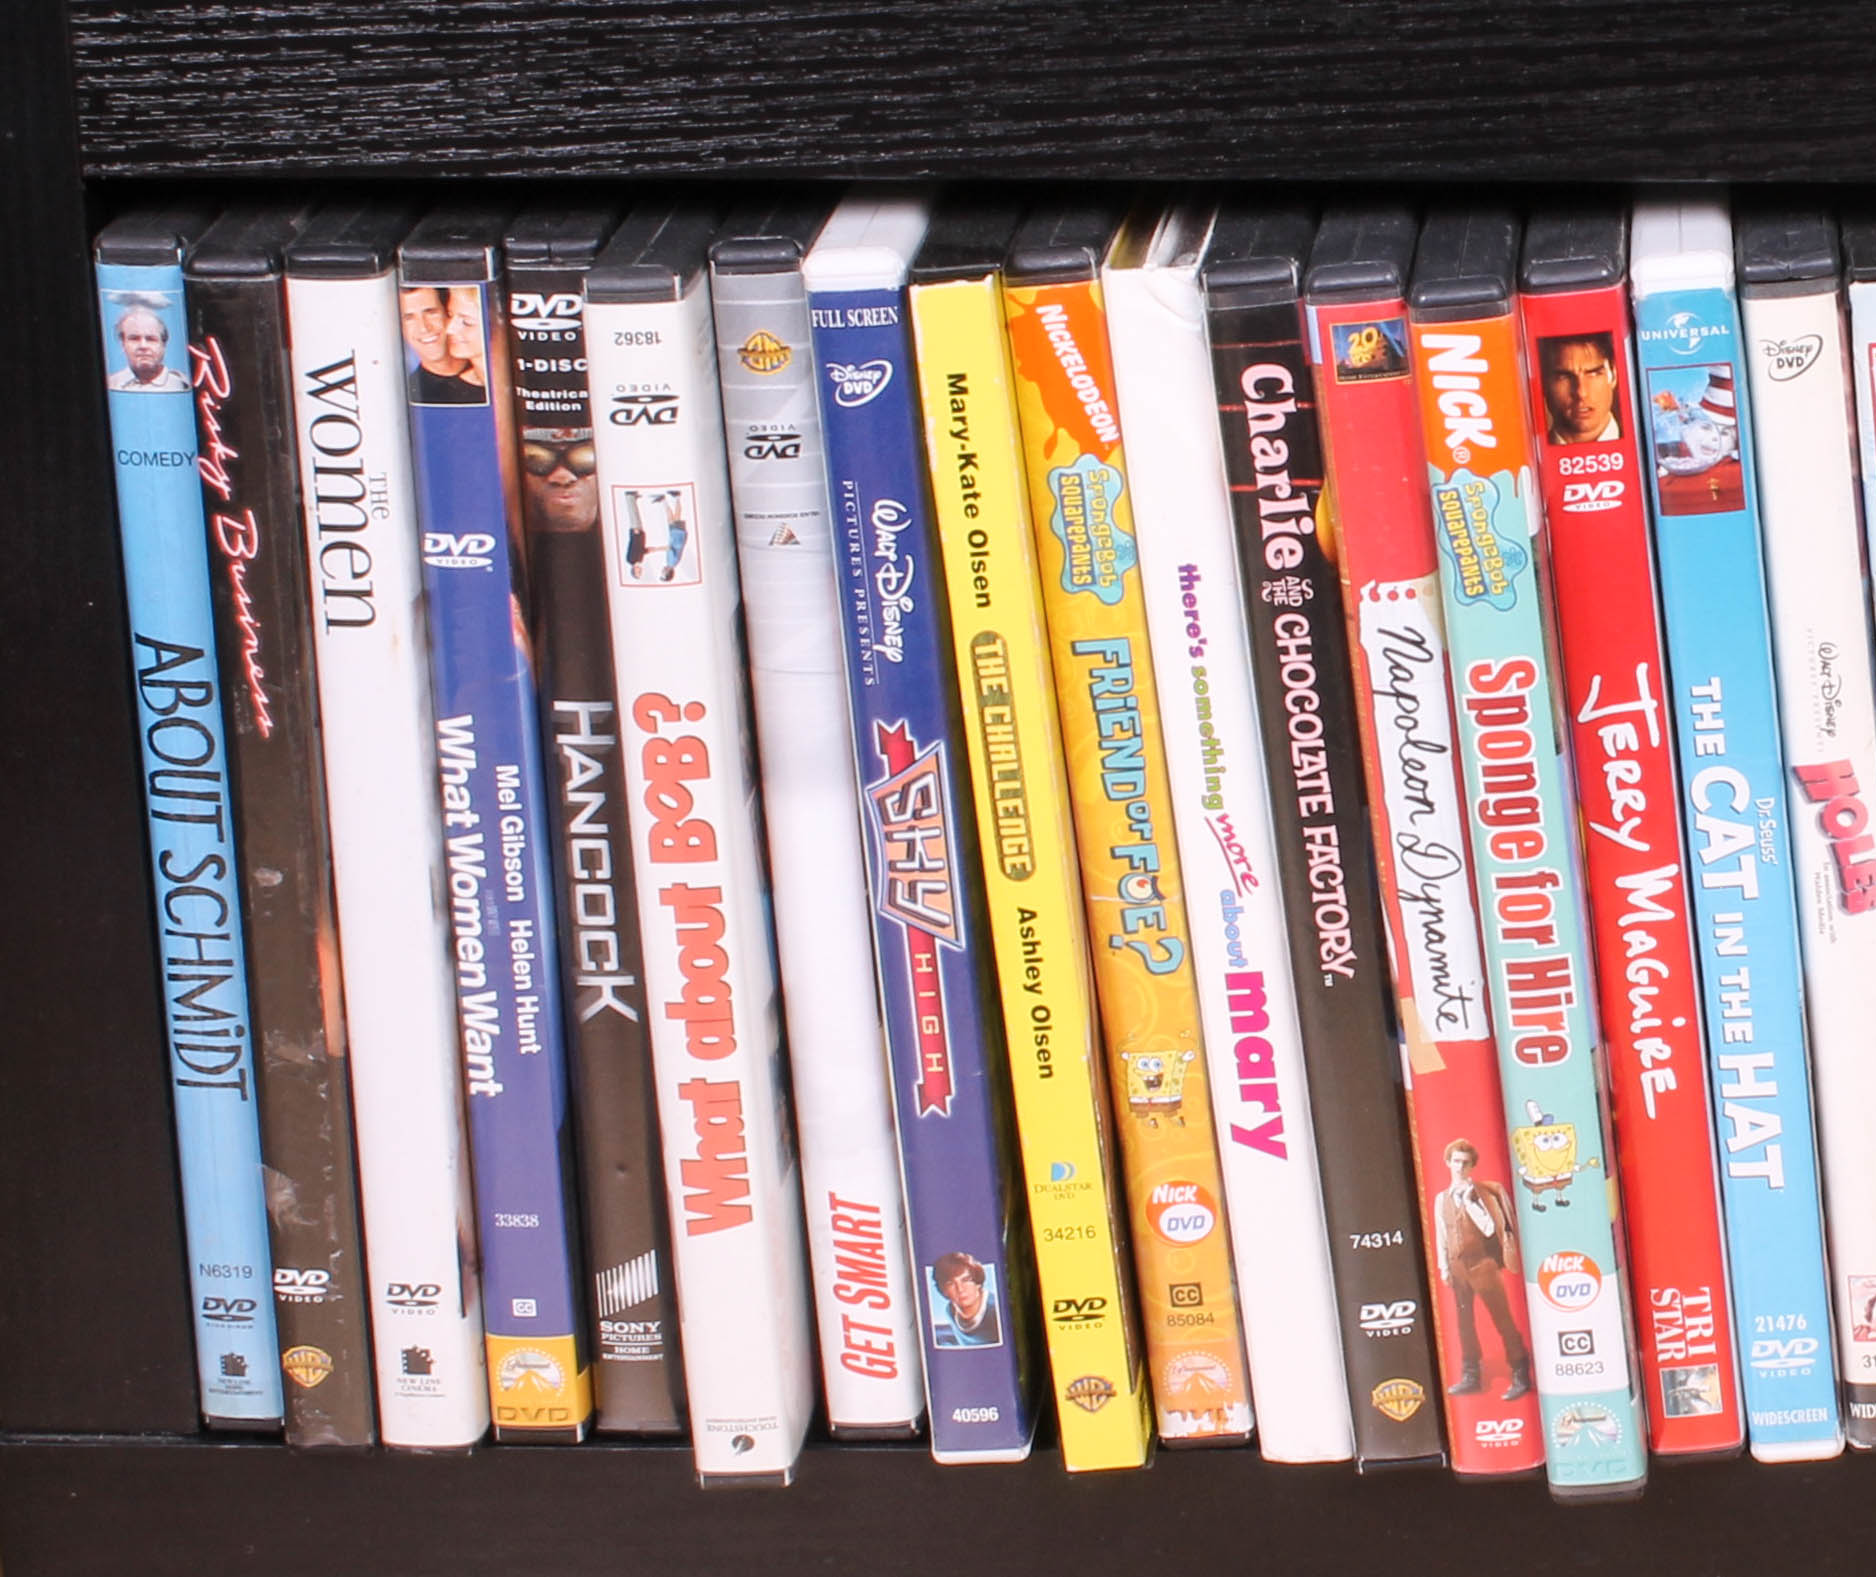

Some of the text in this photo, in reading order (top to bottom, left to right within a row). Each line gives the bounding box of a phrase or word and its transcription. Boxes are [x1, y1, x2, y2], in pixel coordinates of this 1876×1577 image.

[511, 292, 583, 318] DVD
[613, 331, 662, 346] 18362
[811, 305, 899, 329] FULL SCREEN
[1640, 323, 1730, 342] UNIVERSAL
[117, 448, 195, 467] COMEDY
[945, 371, 992, 610] Mary-Kate Olsen
[1240, 362, 1316, 571] Charlie
[1558, 452, 1625, 477] 82539
[188, 335, 274, 740] Risky Business
[842, 479, 876, 687] PICTURES PRESENTS
[1272, 579, 1287, 606] THE
[1284, 577, 1304, 608] AND
[973, 639, 1010, 697] THE
[134, 631, 226, 844] ABOUT
[1576, 661, 1661, 852] JERRY
[1273, 611, 1357, 981] CHOCOLATE FACTORY
[1373, 625, 1475, 1034] Napoleon Dynamite
[552, 699, 640, 1024] HANCOCK
[876, 770, 953, 929] SKY
[1177, 563, 1289, 1162] there's something more about mary
[1464, 658, 1577, 1070] Sponge for Hire
[436, 714, 504, 1098] What Women Want
[495, 764, 542, 1055] Mel Gibson Helen Hunt
[1689, 676, 1786, 1190] THE CAT IN THE HAT
[658, 881, 738, 1061] about
[913, 951, 944, 1073] HIGH
[1017, 906, 1054, 1080] Ashley Olsen
[677, 1077, 754, 1238] What
[494, 1213, 540, 1228] 33838
[1043, 1225, 1097, 1243] 34216
[1349, 1230, 1404, 1250] 74314
[199, 1263, 253, 1280] N6319
[828, 1190, 899, 1380] GET SMART
[599, 1320, 661, 1334] SONY
[1554, 1361, 1605, 1377] 88623
[1649, 1286, 1688, 1363] STAR
[1682, 1286, 1718, 1360] TRI
[1754, 1315, 1807, 1333] 21476
[951, 1406, 1000, 1424] 40596
[1751, 1408, 1829, 1427] WIDESCREEN
